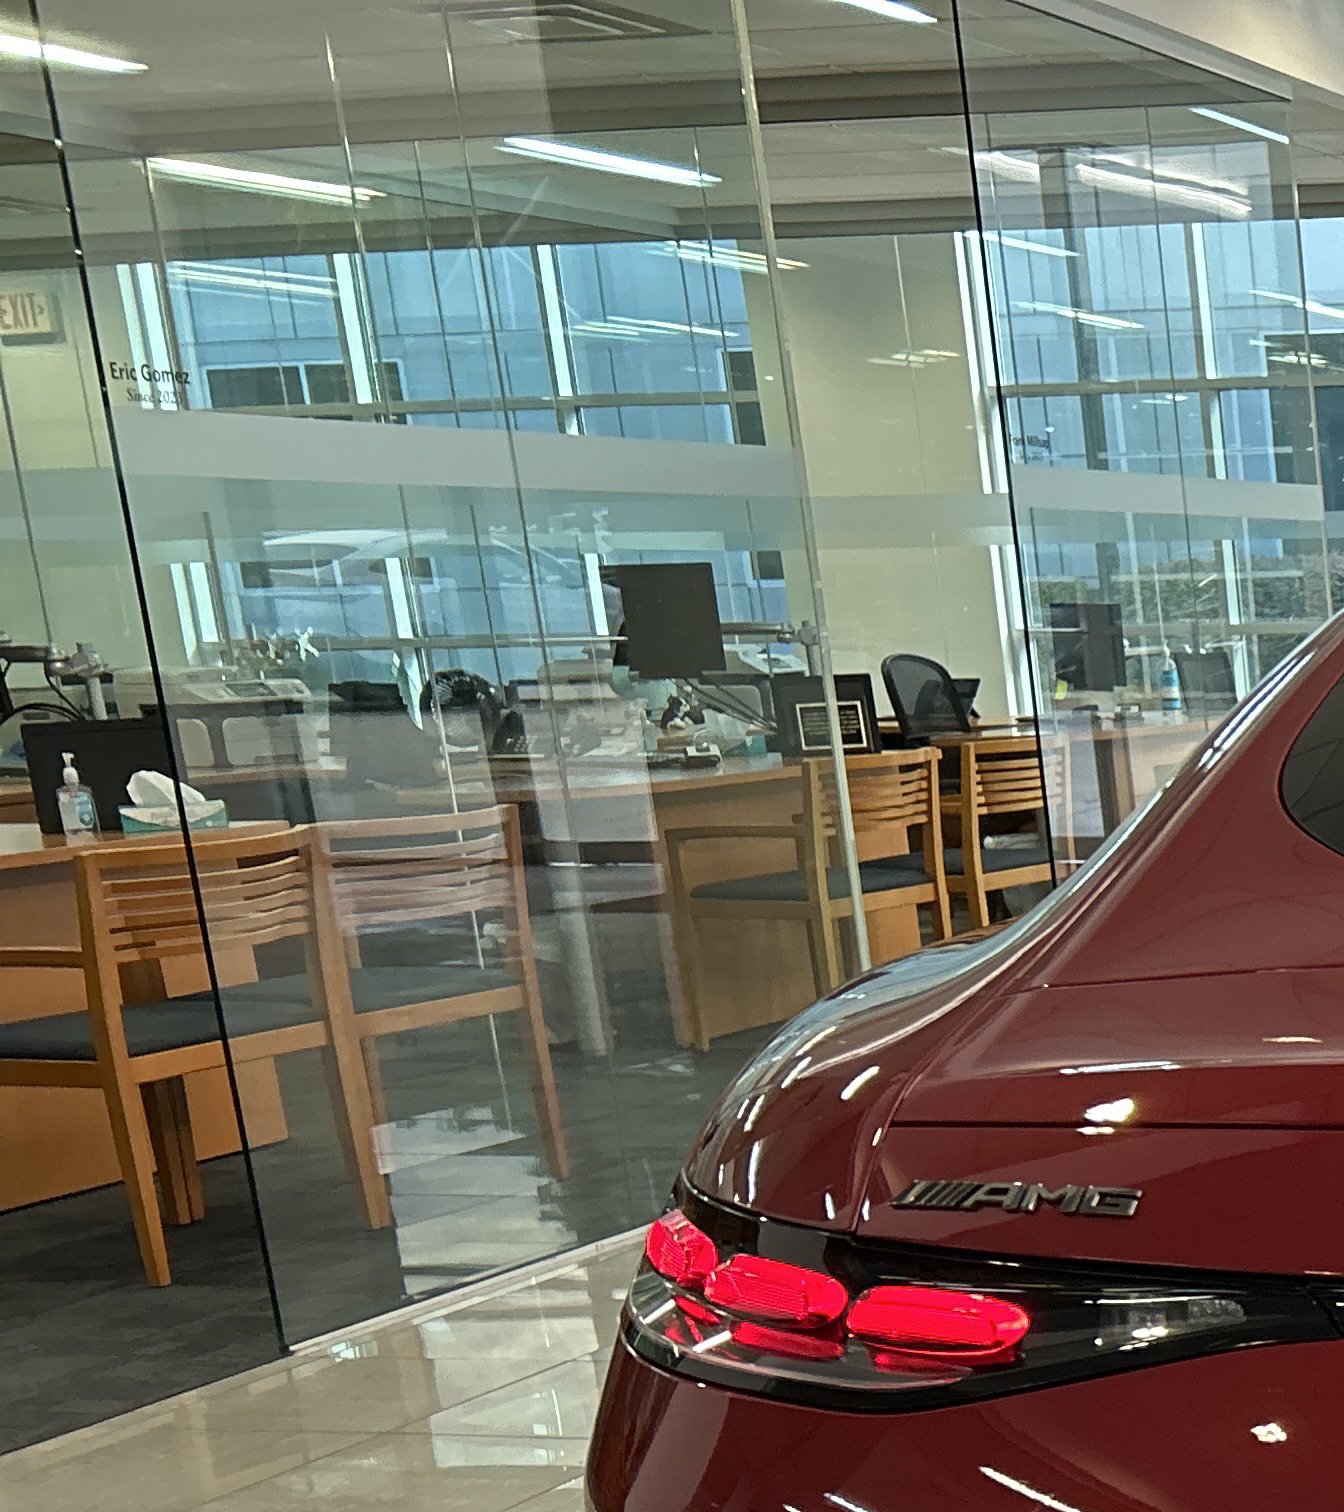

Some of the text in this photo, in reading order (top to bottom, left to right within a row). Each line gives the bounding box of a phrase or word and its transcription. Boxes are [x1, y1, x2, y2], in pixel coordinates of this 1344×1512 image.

[109, 361, 190, 384] Eric Gomez
[960, 1181, 1143, 1216] AMG
